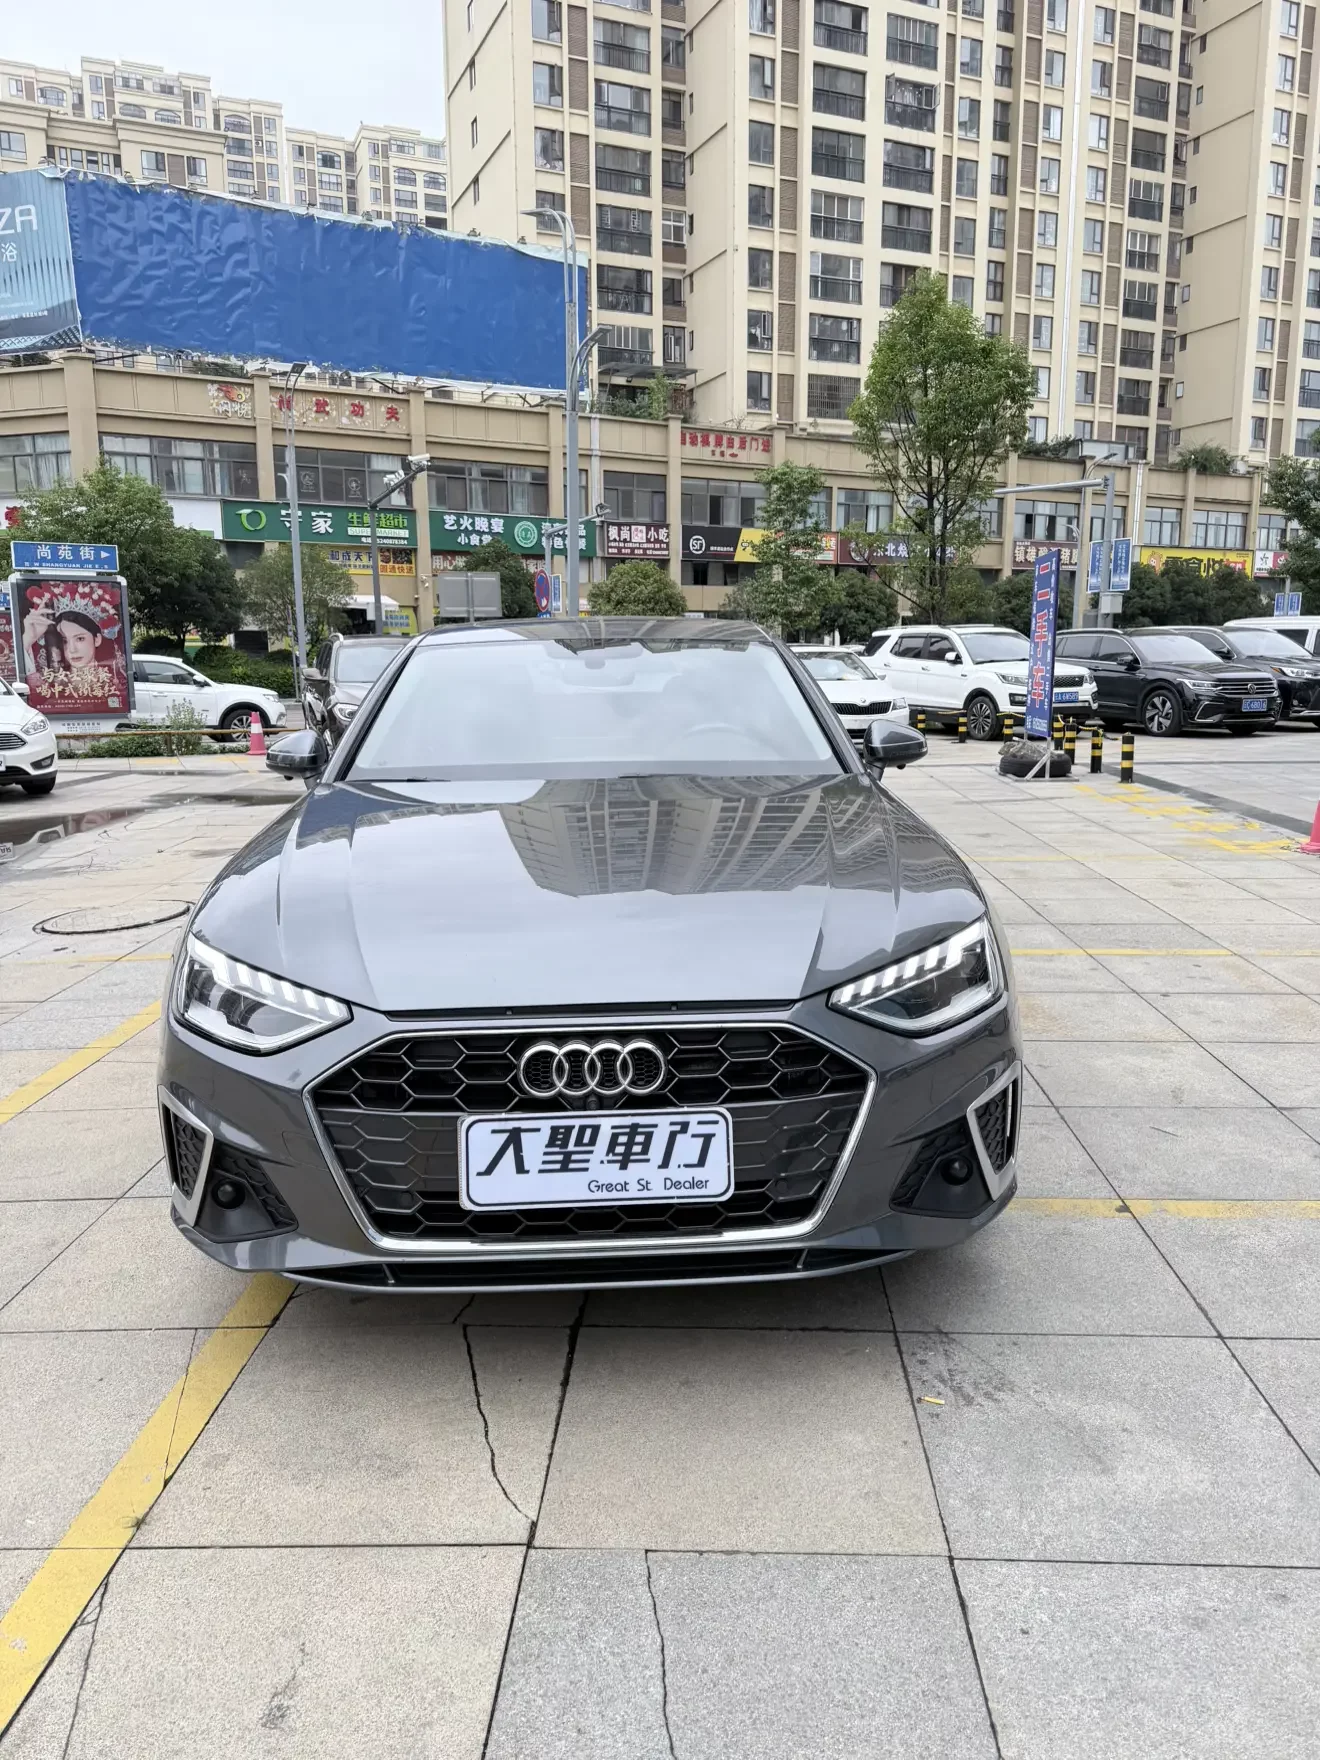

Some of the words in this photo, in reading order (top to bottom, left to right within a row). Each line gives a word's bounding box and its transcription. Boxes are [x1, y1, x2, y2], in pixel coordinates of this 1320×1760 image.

[1, 242, 18, 262] 浴
[647, 526, 669, 543] 小吃
[37, 544, 94, 560] 尚苑街
[476, 1119, 720, 1176] 大聖車行
[588, 1179, 630, 1193] Great
[664, 1176, 710, 1191] Dealer
